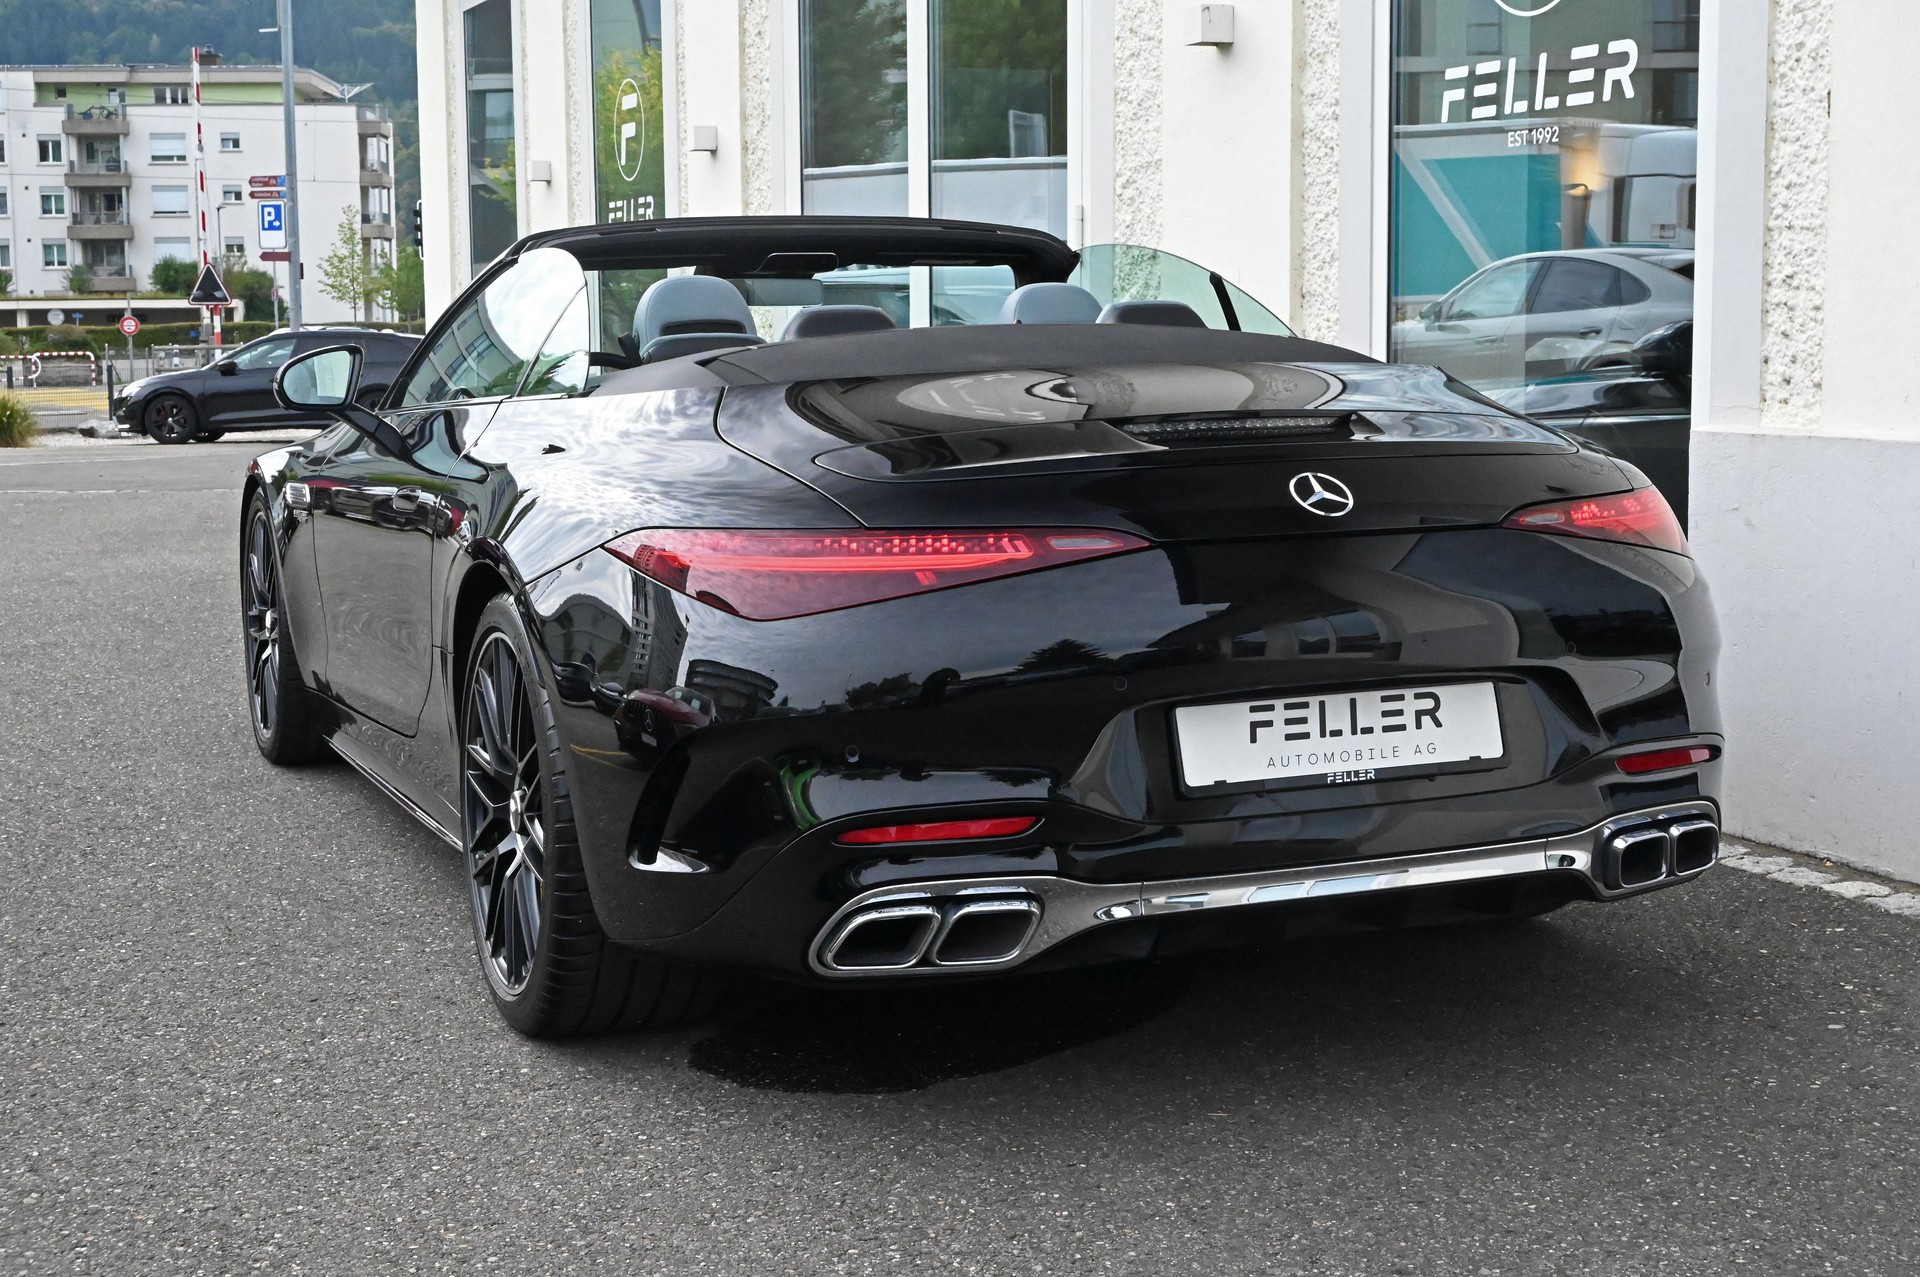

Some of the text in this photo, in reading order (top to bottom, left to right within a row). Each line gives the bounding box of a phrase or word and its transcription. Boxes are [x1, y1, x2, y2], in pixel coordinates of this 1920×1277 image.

[1440, 38, 1639, 124] FELLER
[620, 92, 638, 166] F
[1507, 125, 1560, 148] EST 1992
[263, 206, 276, 229] P
[1248, 691, 1443, 744] FELLER
[1266, 742, 1438, 769] AUTOMOBILE AG
[1326, 769, 1376, 785] FELLER
